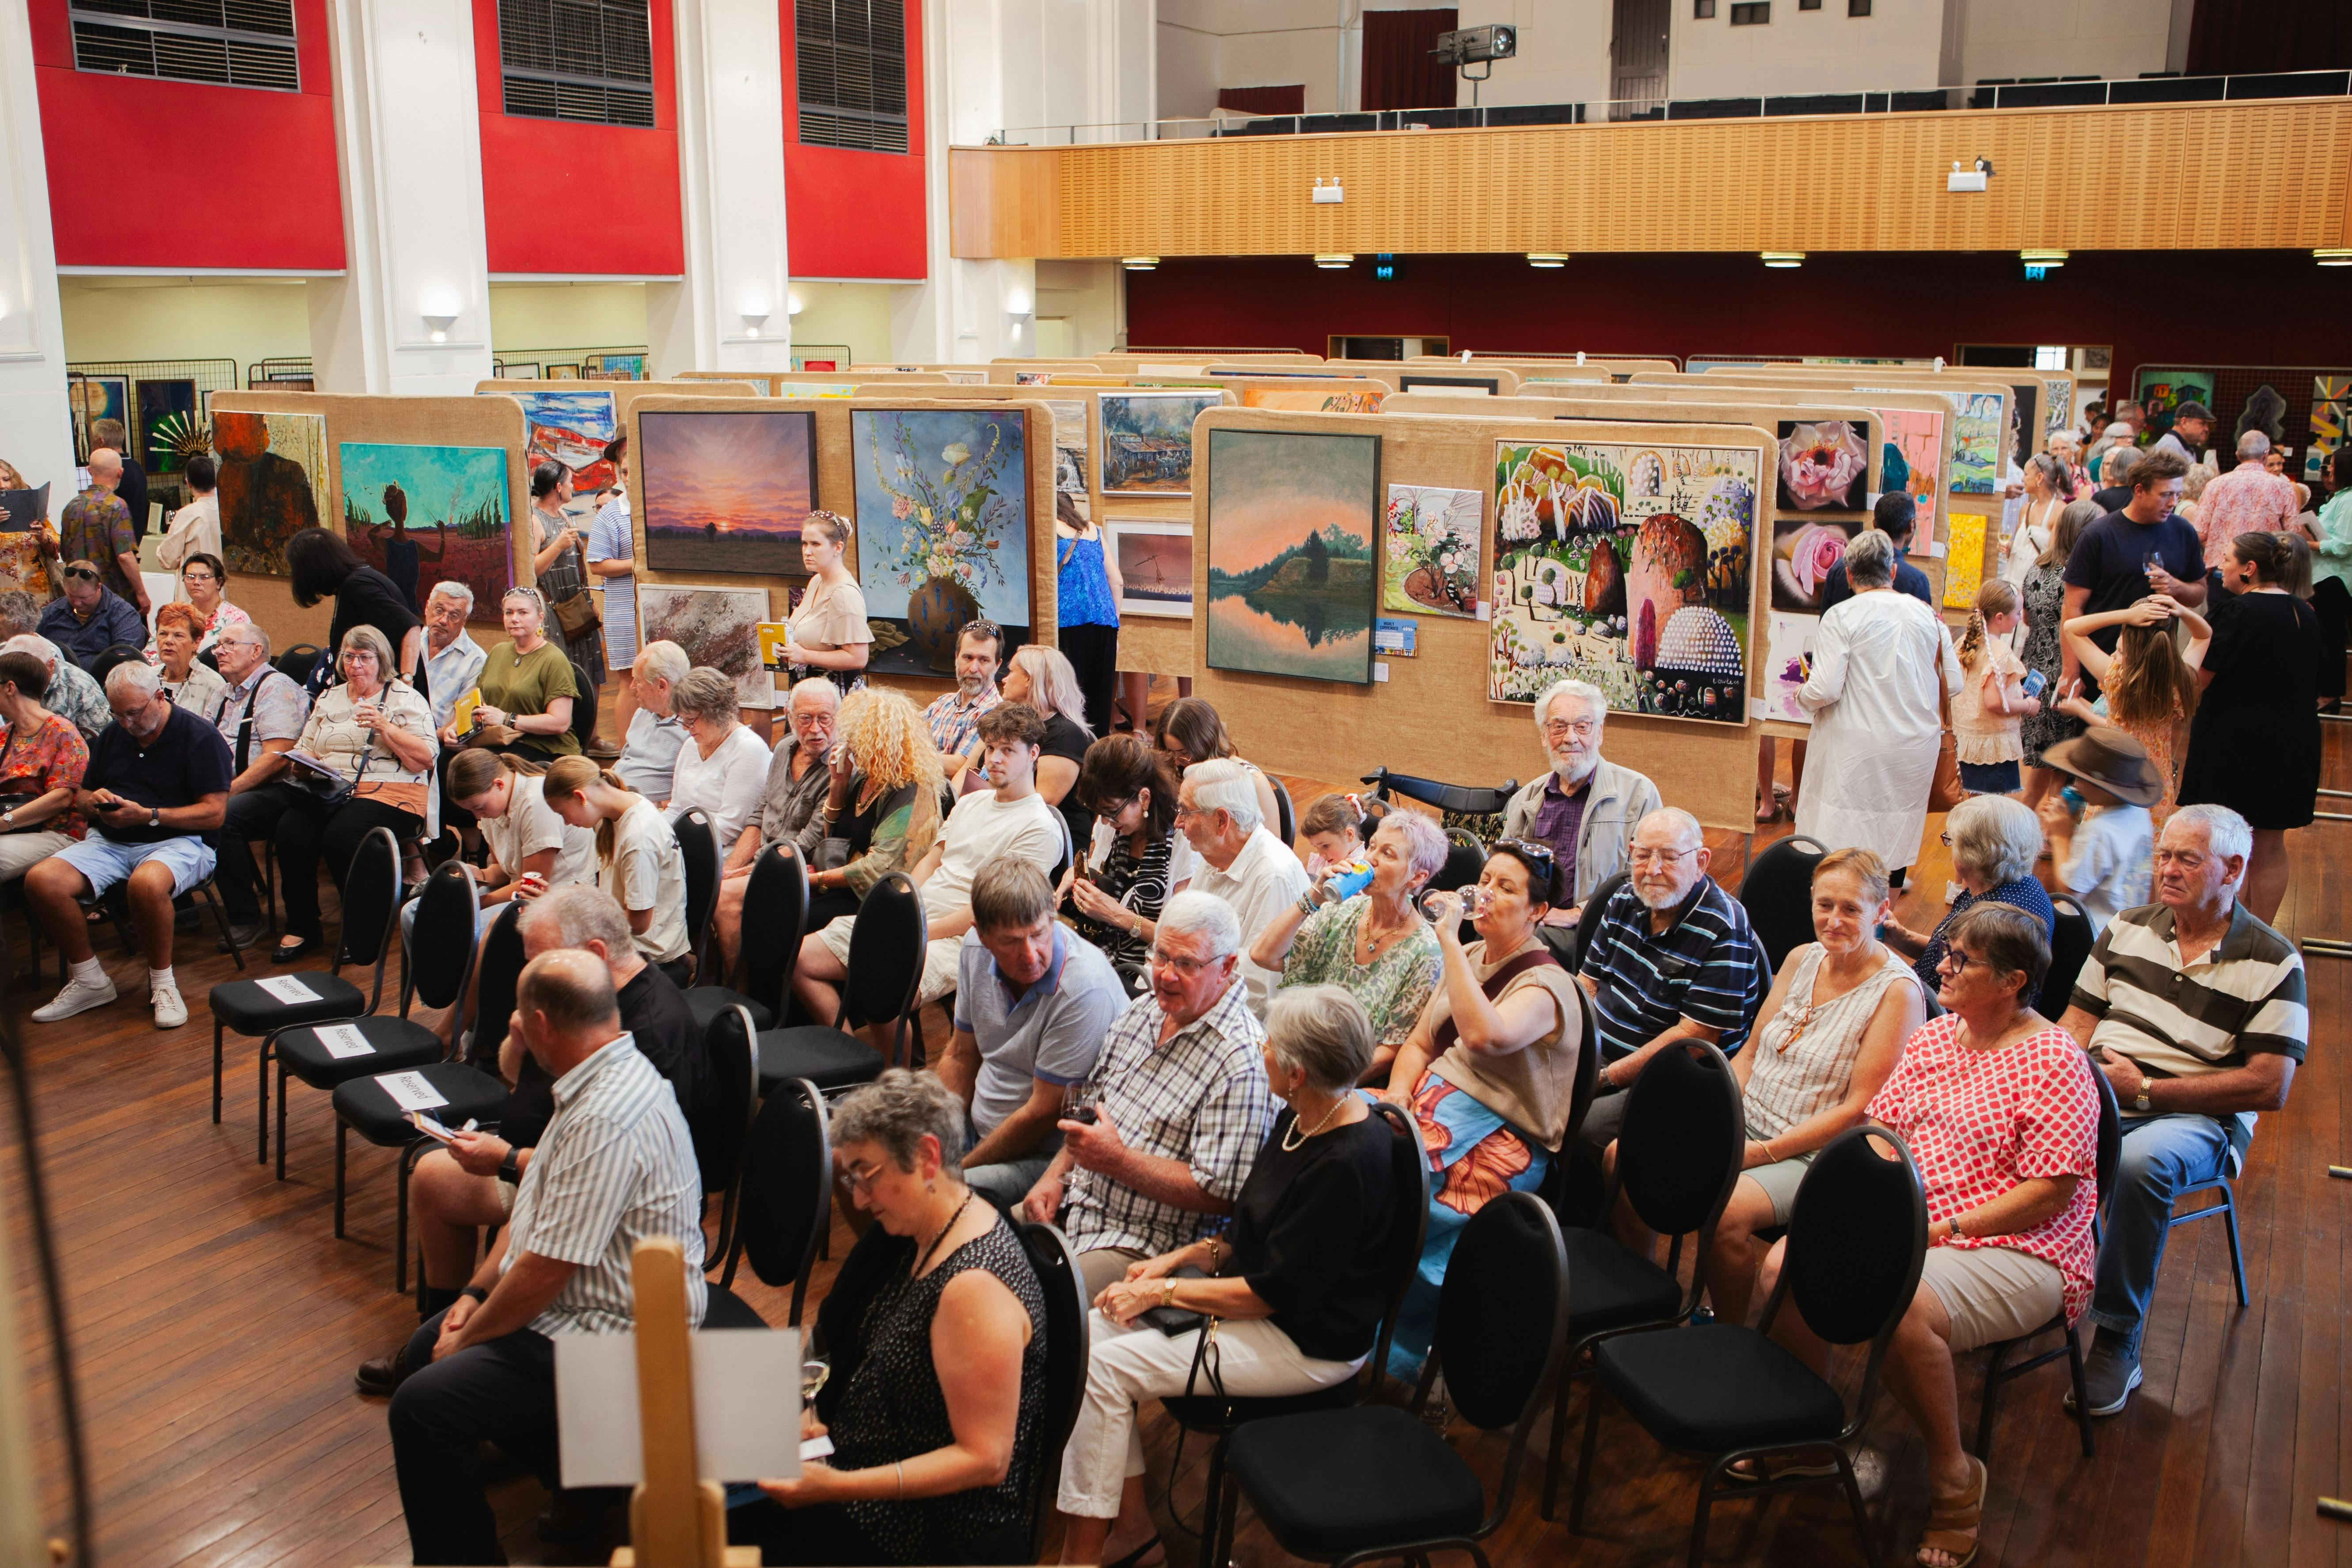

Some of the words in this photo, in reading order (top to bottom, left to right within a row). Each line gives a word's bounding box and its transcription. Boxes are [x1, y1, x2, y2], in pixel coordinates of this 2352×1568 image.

[275, 979, 308, 996] Reserved
[335, 1028, 362, 1048] Reserved
[398, 1076, 433, 1099] Reserved
